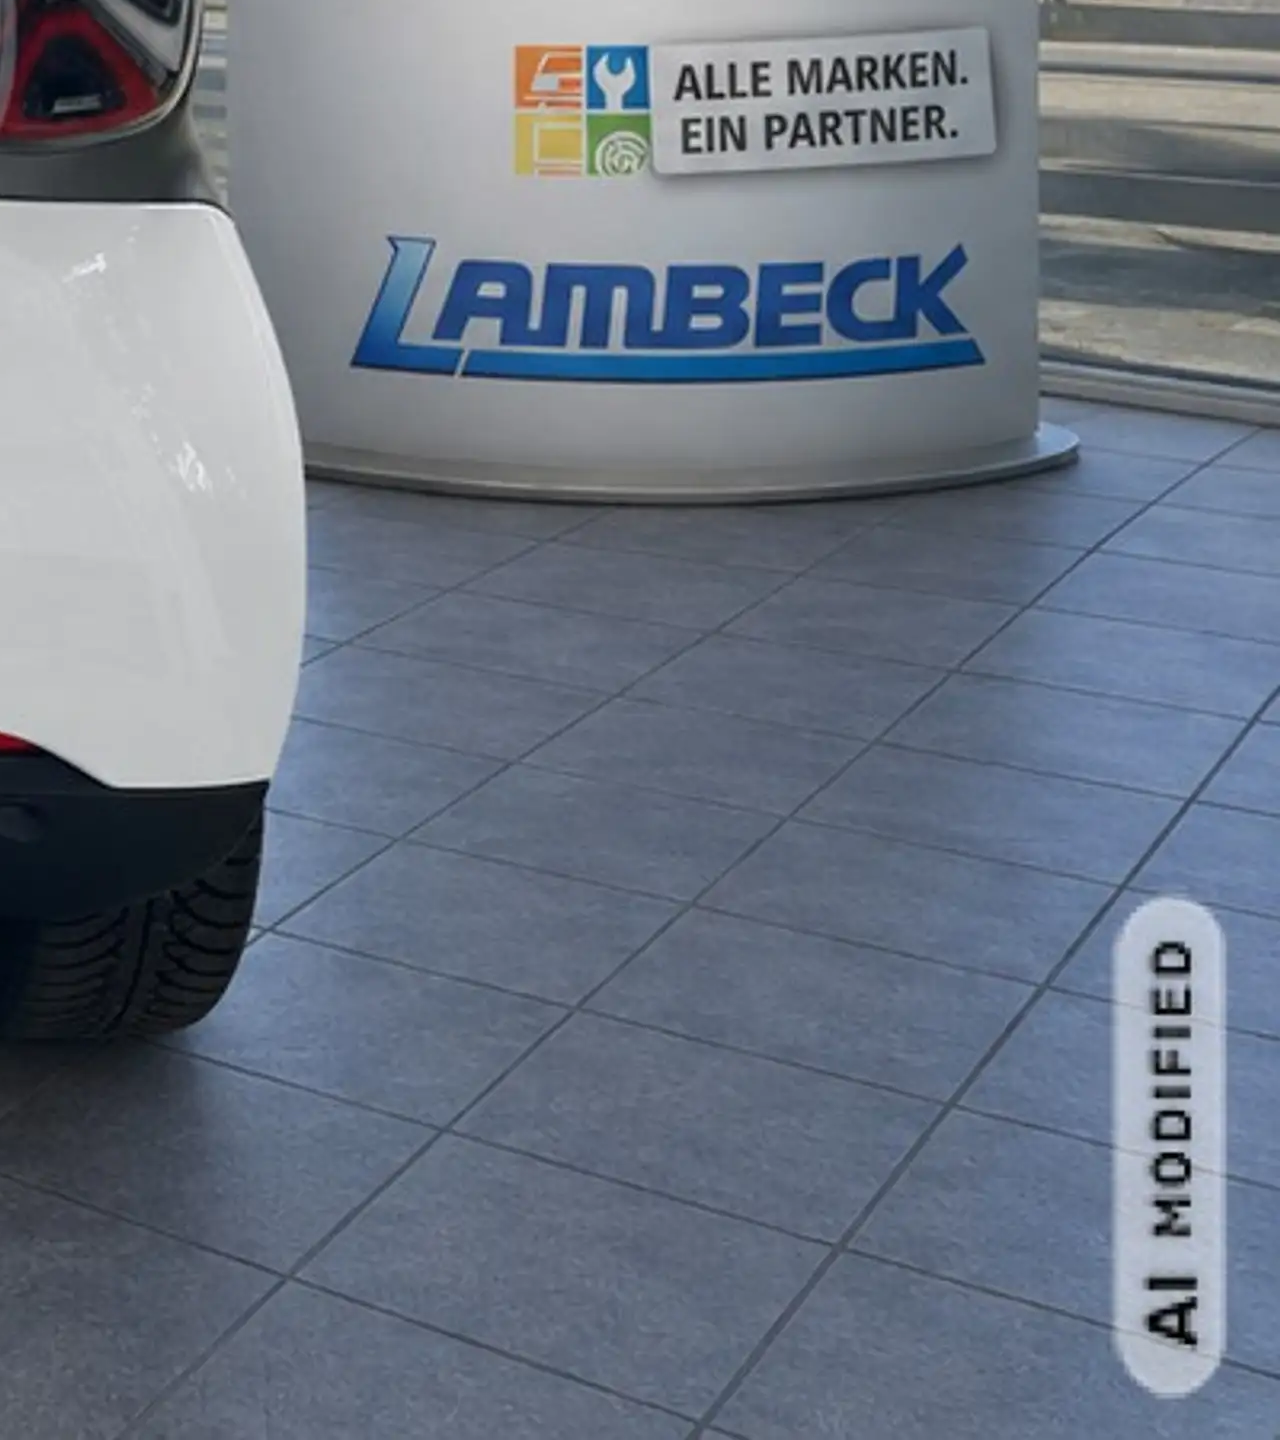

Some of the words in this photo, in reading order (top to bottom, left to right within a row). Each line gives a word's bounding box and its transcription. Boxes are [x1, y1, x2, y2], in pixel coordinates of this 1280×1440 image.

[673, 61, 773, 101] ALLE
[787, 49, 969, 96] MARKEN.
[680, 115, 747, 154] EIN
[763, 104, 959, 150] PARTNER.
[351, 235, 969, 377] LAMBECK
